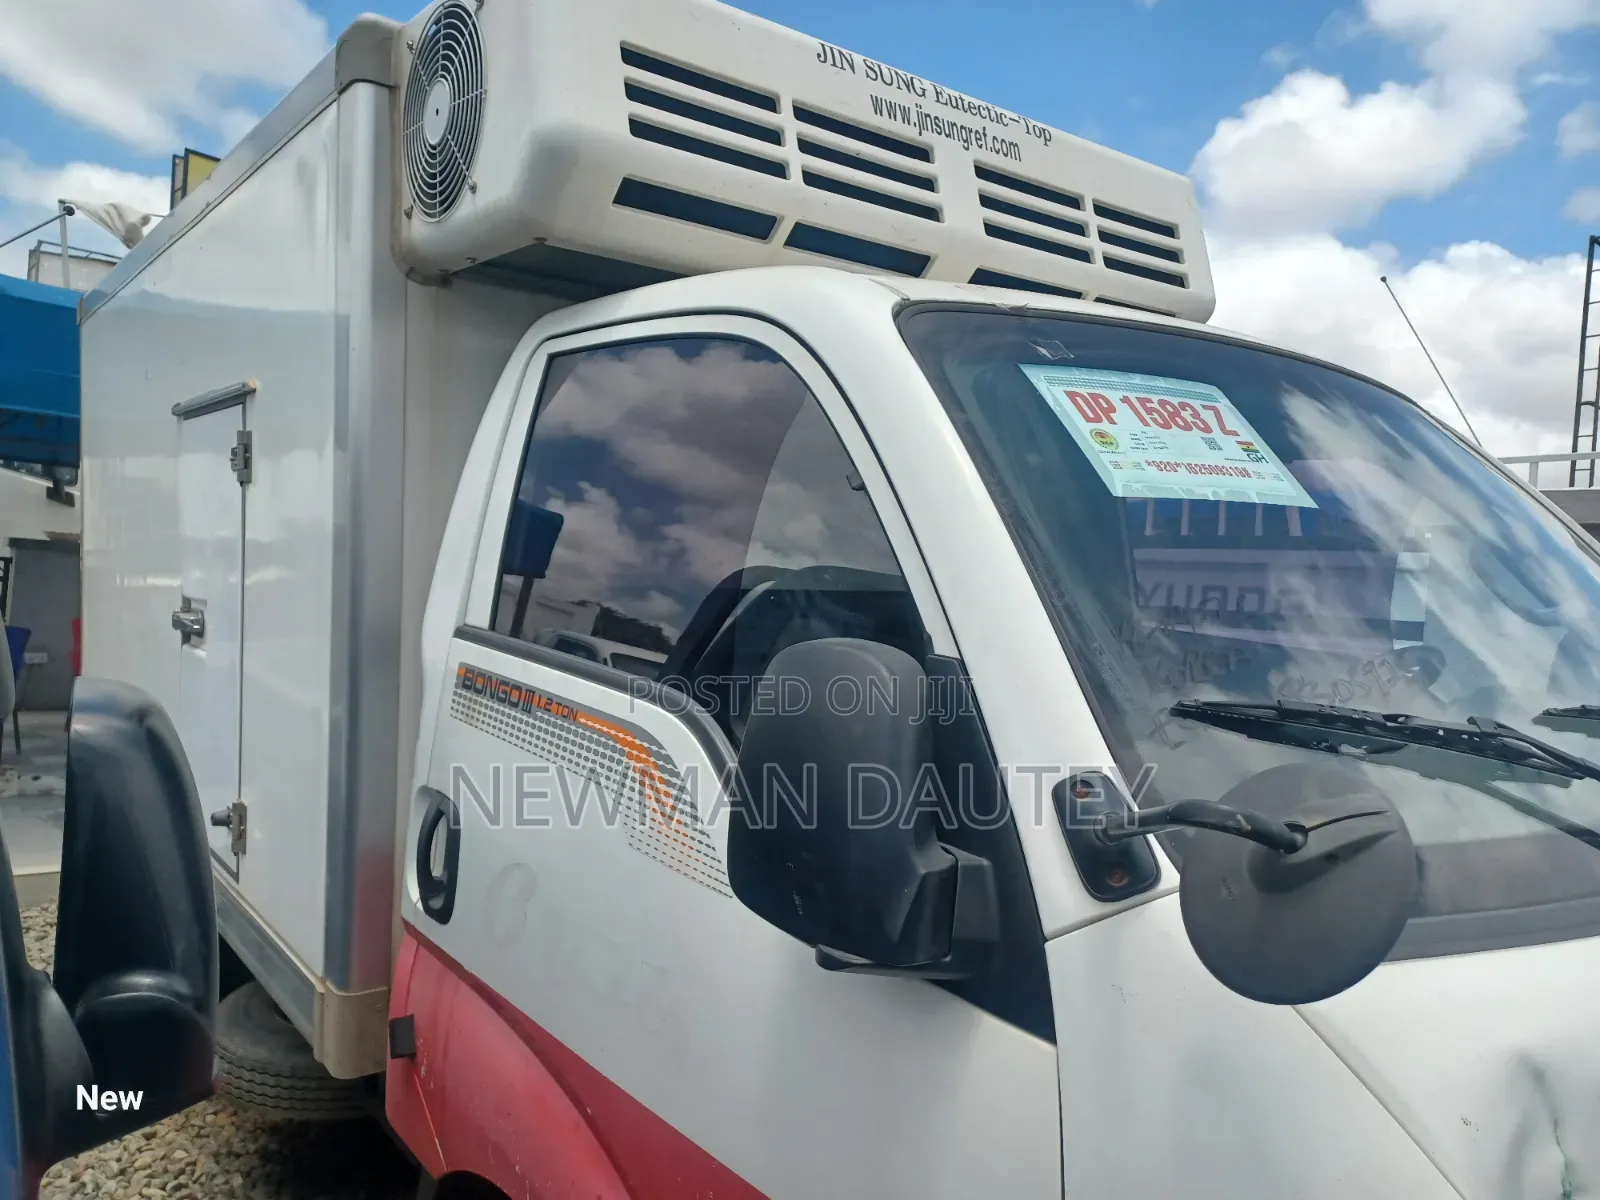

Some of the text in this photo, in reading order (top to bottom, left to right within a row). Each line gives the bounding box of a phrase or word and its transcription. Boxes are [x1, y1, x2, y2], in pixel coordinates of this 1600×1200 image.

[816, 42, 1053, 147] JIN SUNG Eutectic-Top
[869, 93, 1022, 163] www.jinsungref.com
[1063, 390, 1240, 436] DP 1583 Z
[1246, 453, 1269, 464] GH
[462, 667, 522, 708] BONGO
[536, 694, 554, 712] 1.2
[555, 702, 578, 722] TON
